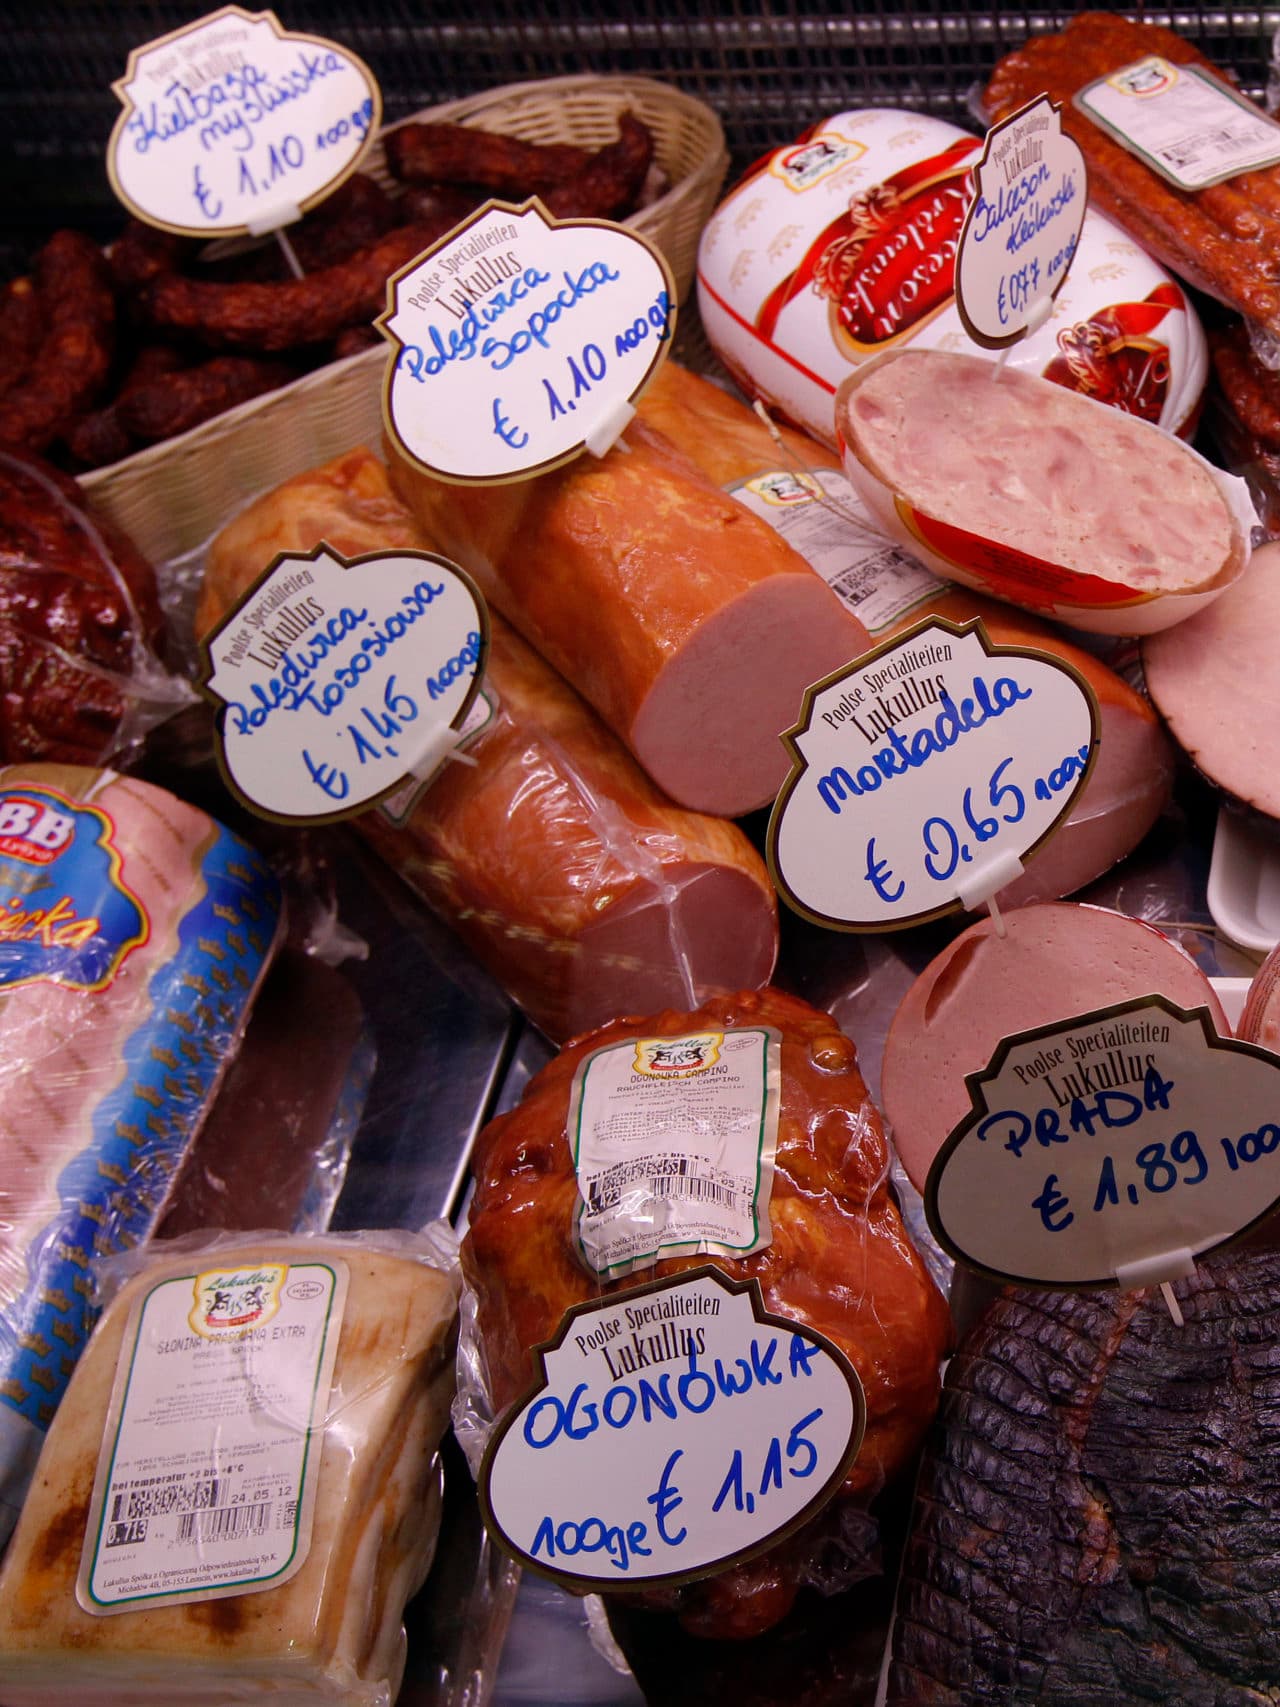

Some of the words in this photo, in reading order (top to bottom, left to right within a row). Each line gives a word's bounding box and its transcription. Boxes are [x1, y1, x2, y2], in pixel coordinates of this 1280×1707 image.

[192, 164, 223, 220] €
[407, 271, 446, 312] Poolse
[438, 222, 519, 276] Specialiteiten
[434, 251, 523, 320] Lukullus
[480, 261, 620, 370] Sopocka
[997, 275, 1009, 324] €
[492, 397, 530, 449] €
[221, 627, 255, 669] Poolse
[242, 568, 315, 630] Specialiteiten
[247, 595, 326, 672] Lukullus
[821, 685, 866, 731] Poolse
[863, 643, 953, 694] Specialiteiten
[849, 673, 949, 746] Lukullus
[302, 748, 350, 800] €
[864, 837, 905, 903] €
[685, 1065, 728, 1078] CAMPINO
[1012, 1048, 1065, 1086] Poolse
[1065, 1021, 1171, 1059] Specialiteiten
[1042, 1050, 1158, 1109] Lukullus
[976, 1066, 1175, 1157] PRADA
[1031, 1172, 1075, 1233] €
[204, 1271, 279, 1291] Lukullus
[272, 1326, 306, 1341] EXTRA
[575, 1317, 622, 1357] Poolse
[624, 1293, 721, 1331] Specialiteiten
[600, 1322, 707, 1382] Lukullus
[523, 1333, 823, 1449] OGONÓWKA
[112, 1482, 128, 1492] bei
[130, 1473, 186, 1488] temperatur
[647, 1449, 688, 1546] €
[711, 1407, 823, 1514] 1,15
